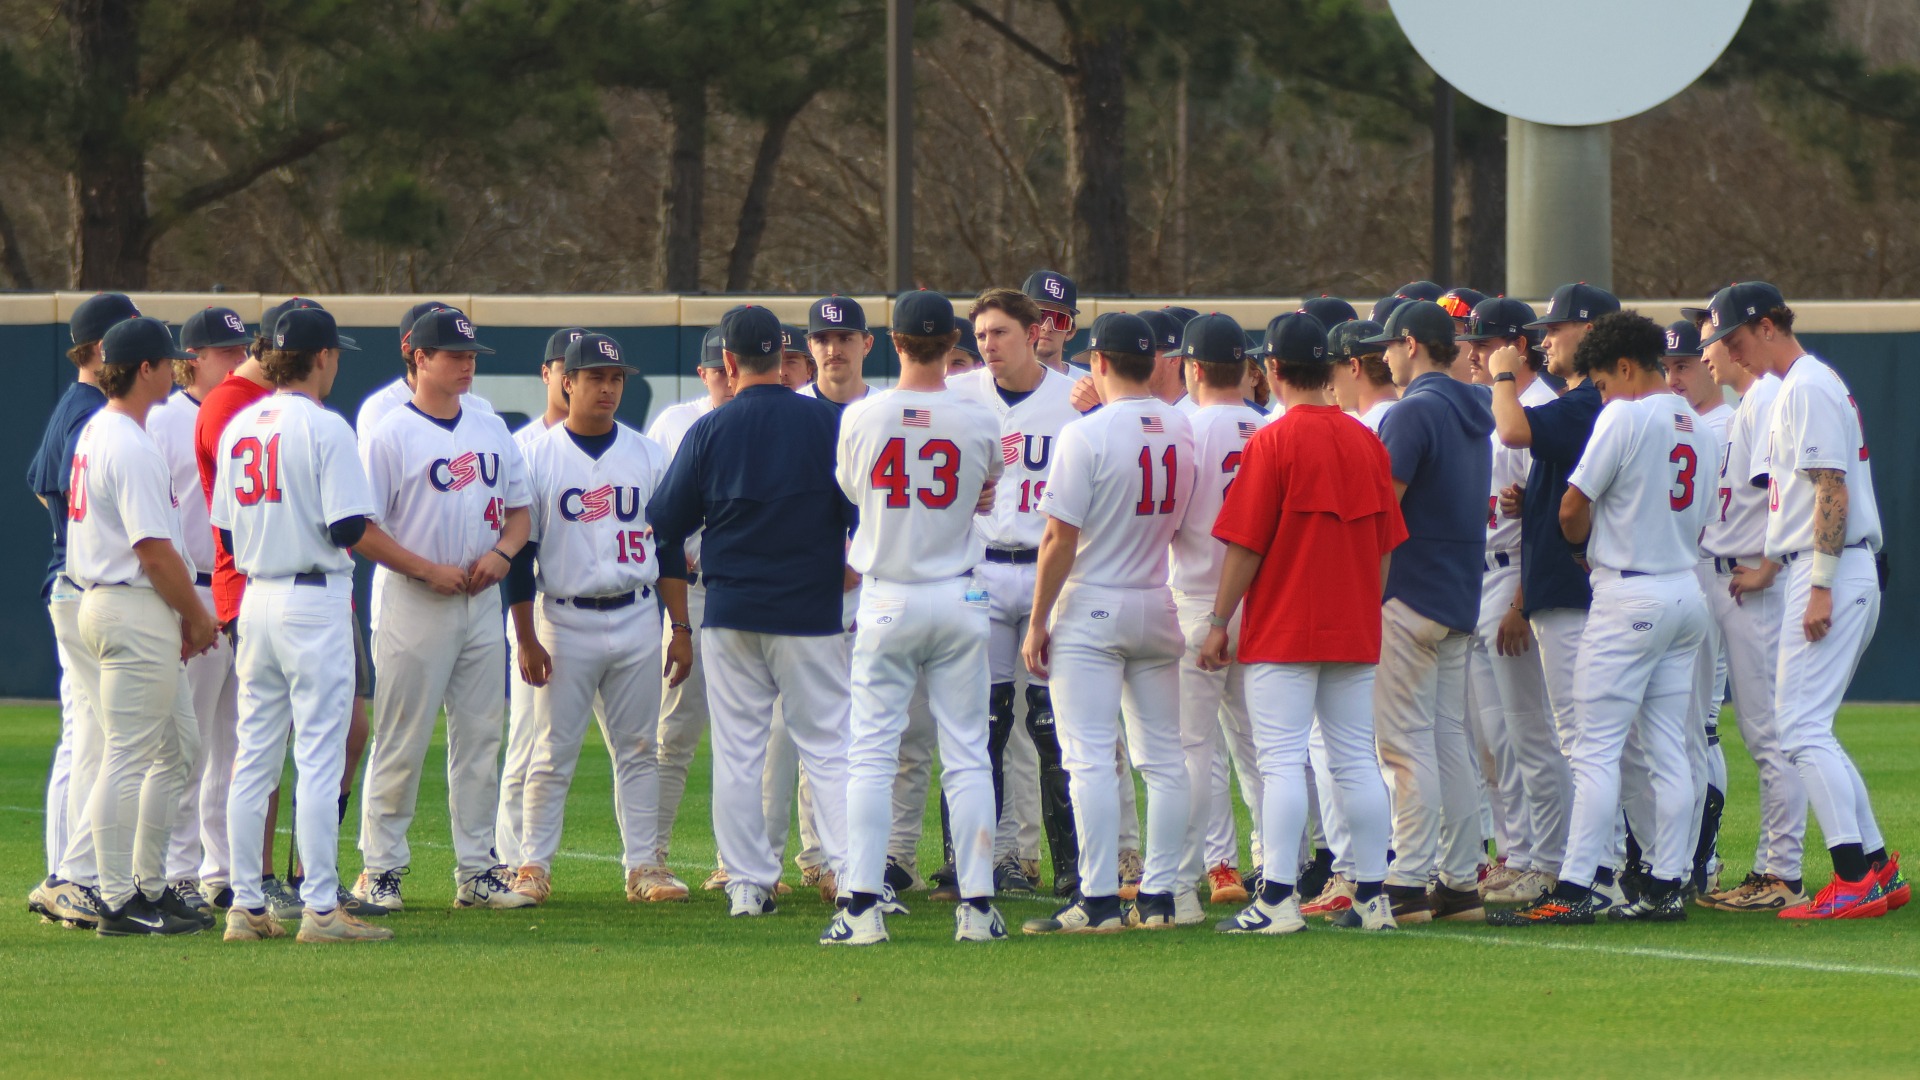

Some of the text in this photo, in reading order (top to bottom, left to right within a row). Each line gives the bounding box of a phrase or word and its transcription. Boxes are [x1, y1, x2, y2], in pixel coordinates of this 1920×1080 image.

[231, 432, 283, 507] 31
[427, 451, 500, 493] CSU
[870, 436, 962, 511] 43
[1001, 431, 1053, 472] SU
[1668, 442, 1698, 513] 3
[558, 483, 641, 524] CSU
[1135, 443, 1178, 517] 11
[615, 529, 647, 565] 15
